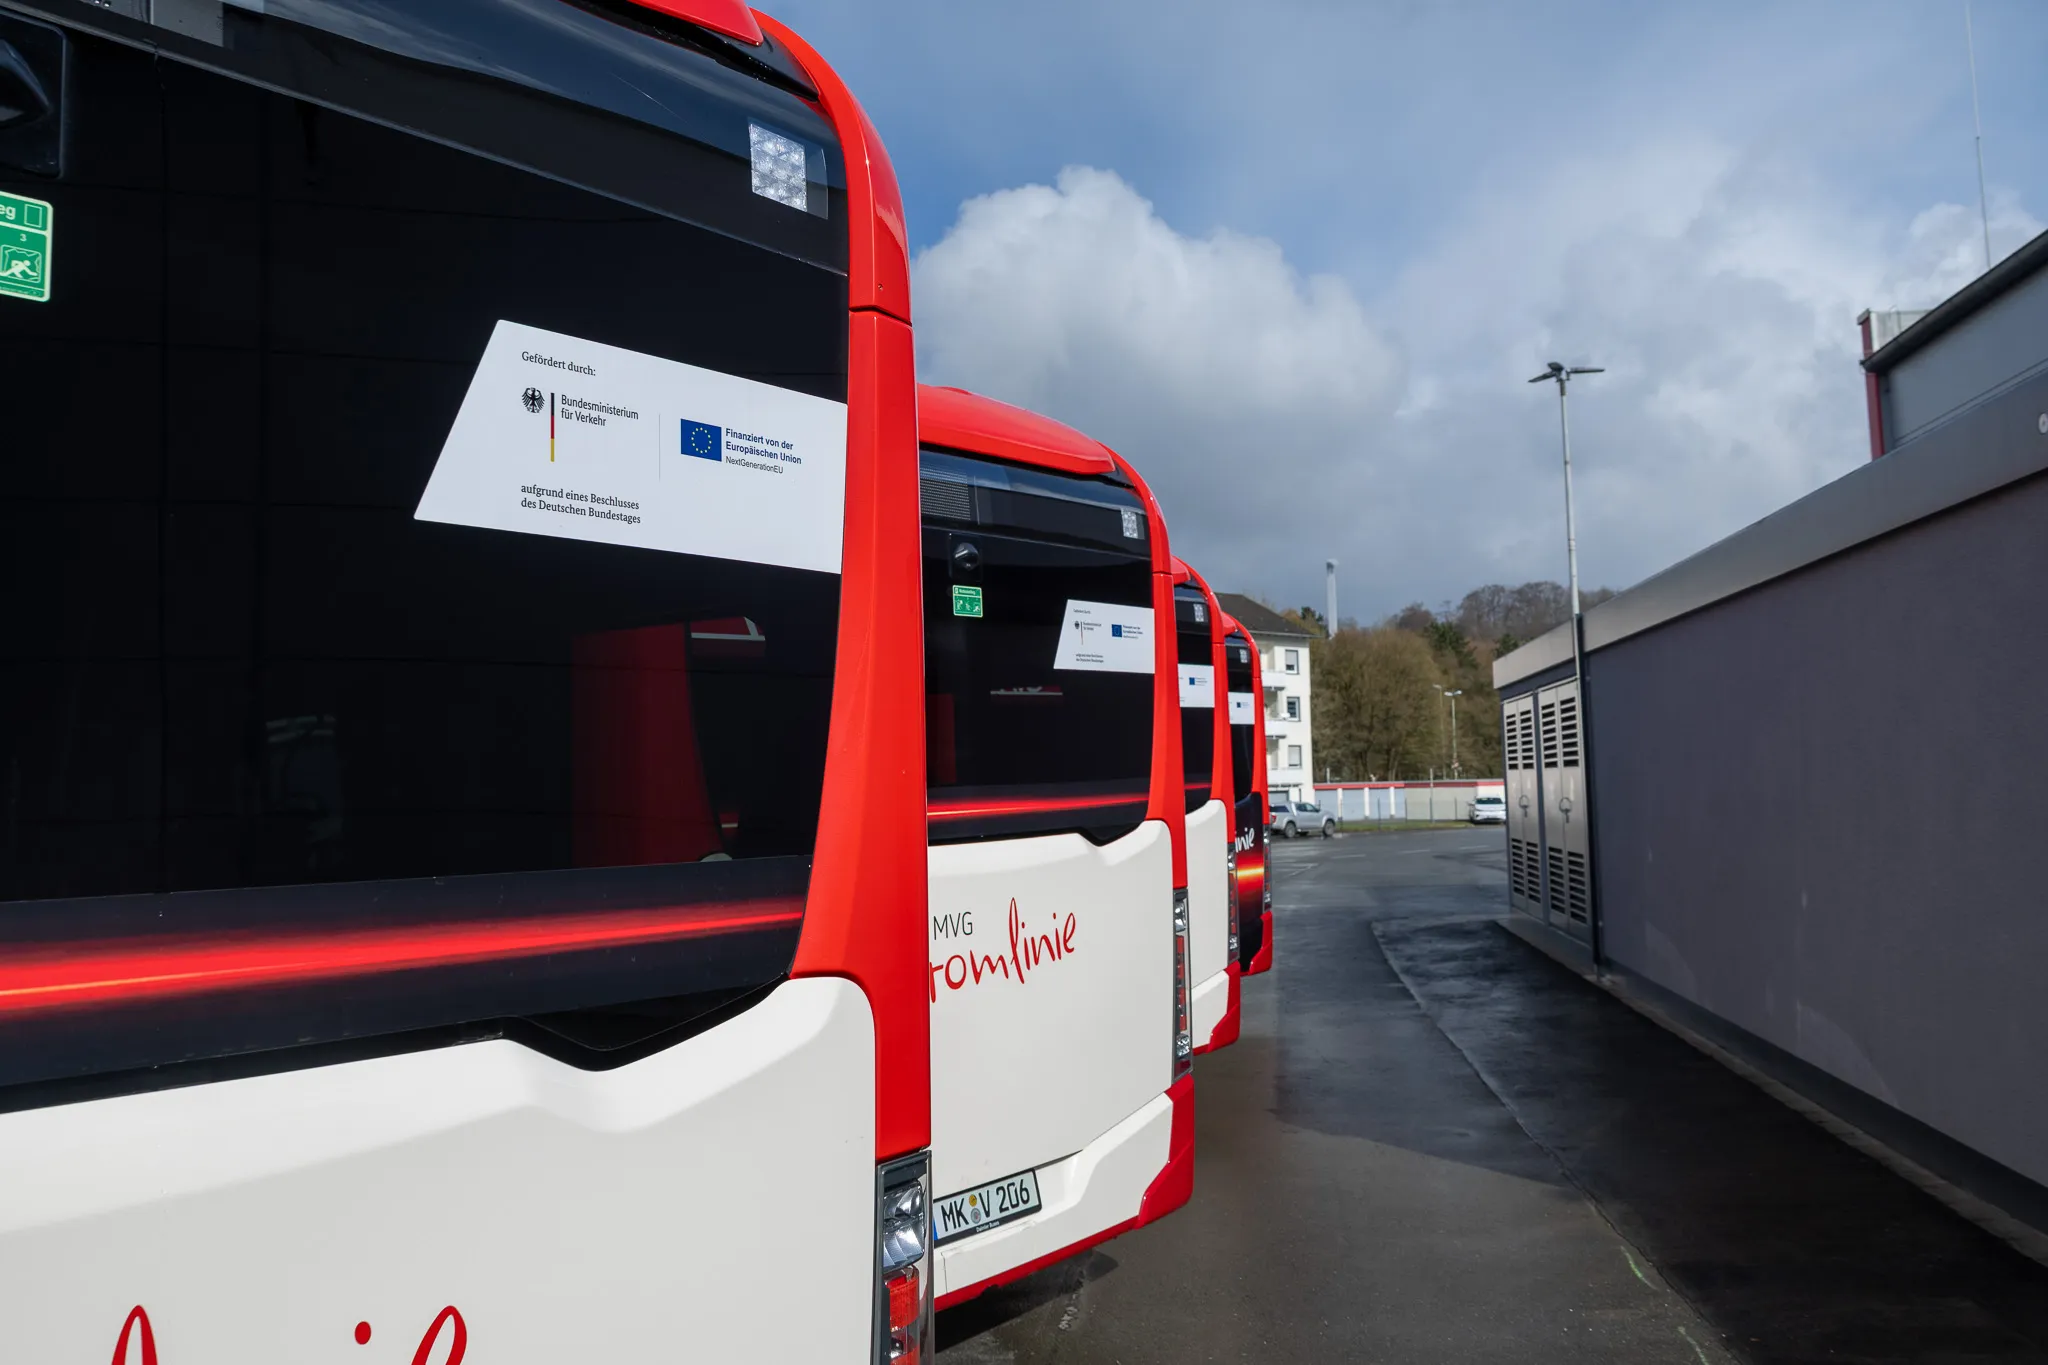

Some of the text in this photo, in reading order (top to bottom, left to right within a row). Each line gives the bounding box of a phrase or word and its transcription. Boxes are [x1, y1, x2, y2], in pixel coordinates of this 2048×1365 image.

[20, 233, 27, 242] 3
[521, 351, 596, 377] Gefördert durch:
[561, 394, 639, 419] Bundesministerium
[561, 407, 606, 426] für Verkehr
[725, 428, 793, 450] Finanziert von der
[725, 441, 801, 464] Europäischen Union
[725, 456, 783, 474] NextGenerationEU
[520, 484, 640, 511] aufgrund eines Beschlusses
[520, 498, 641, 525] des Deutschen Bundestages
[933, 911, 973, 941] MVG
[929, 897, 1076, 1003] romlinie
[940, 1178, 1031, 1233] MK V 206
